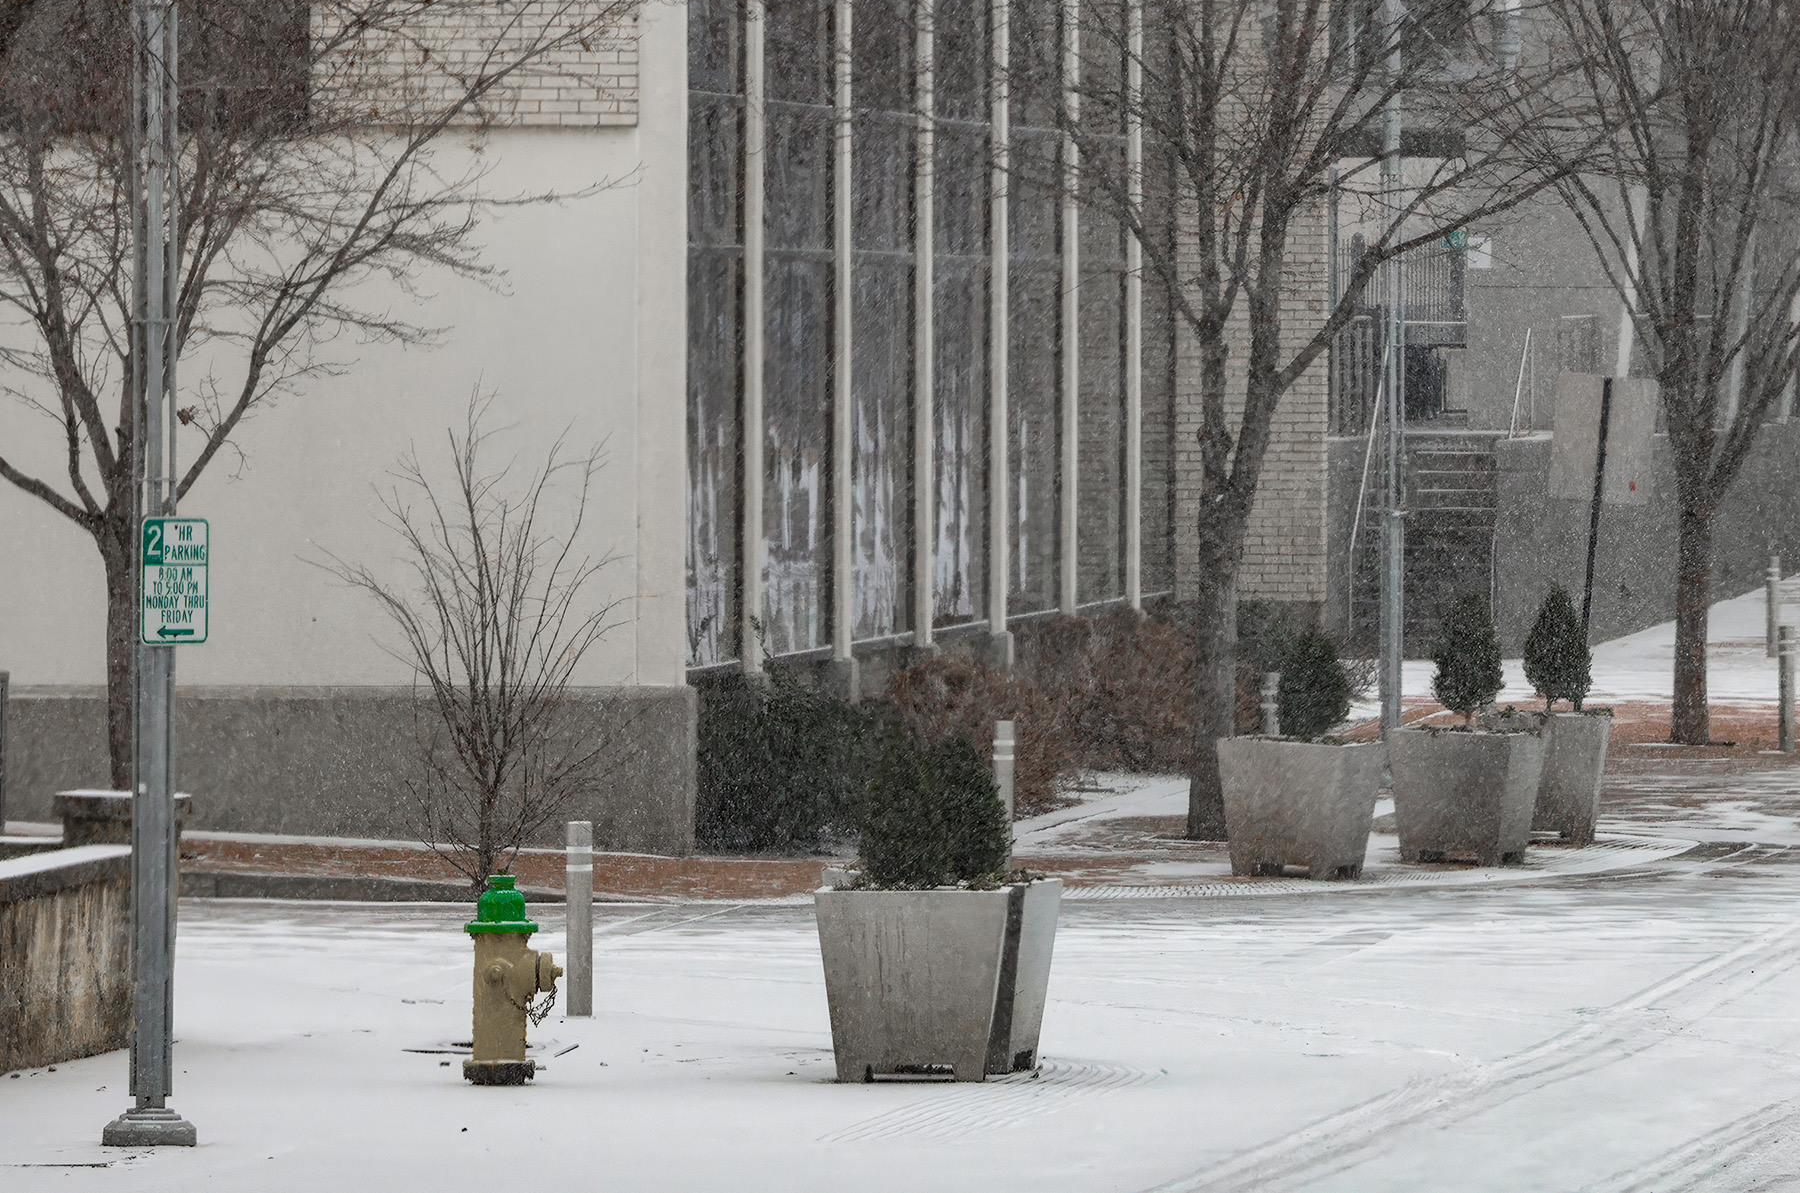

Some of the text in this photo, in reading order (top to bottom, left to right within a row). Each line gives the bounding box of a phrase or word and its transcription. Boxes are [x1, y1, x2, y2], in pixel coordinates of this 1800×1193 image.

[146, 524, 193, 556] 2 HR
[164, 544, 206, 561] PARKING
[180, 567, 193, 581] AM
[153, 581, 163, 595] TO
[187, 581, 199, 595] PM
[146, 594, 205, 609] MONDAY THRU
[161, 610, 193, 624] FRIDAY
